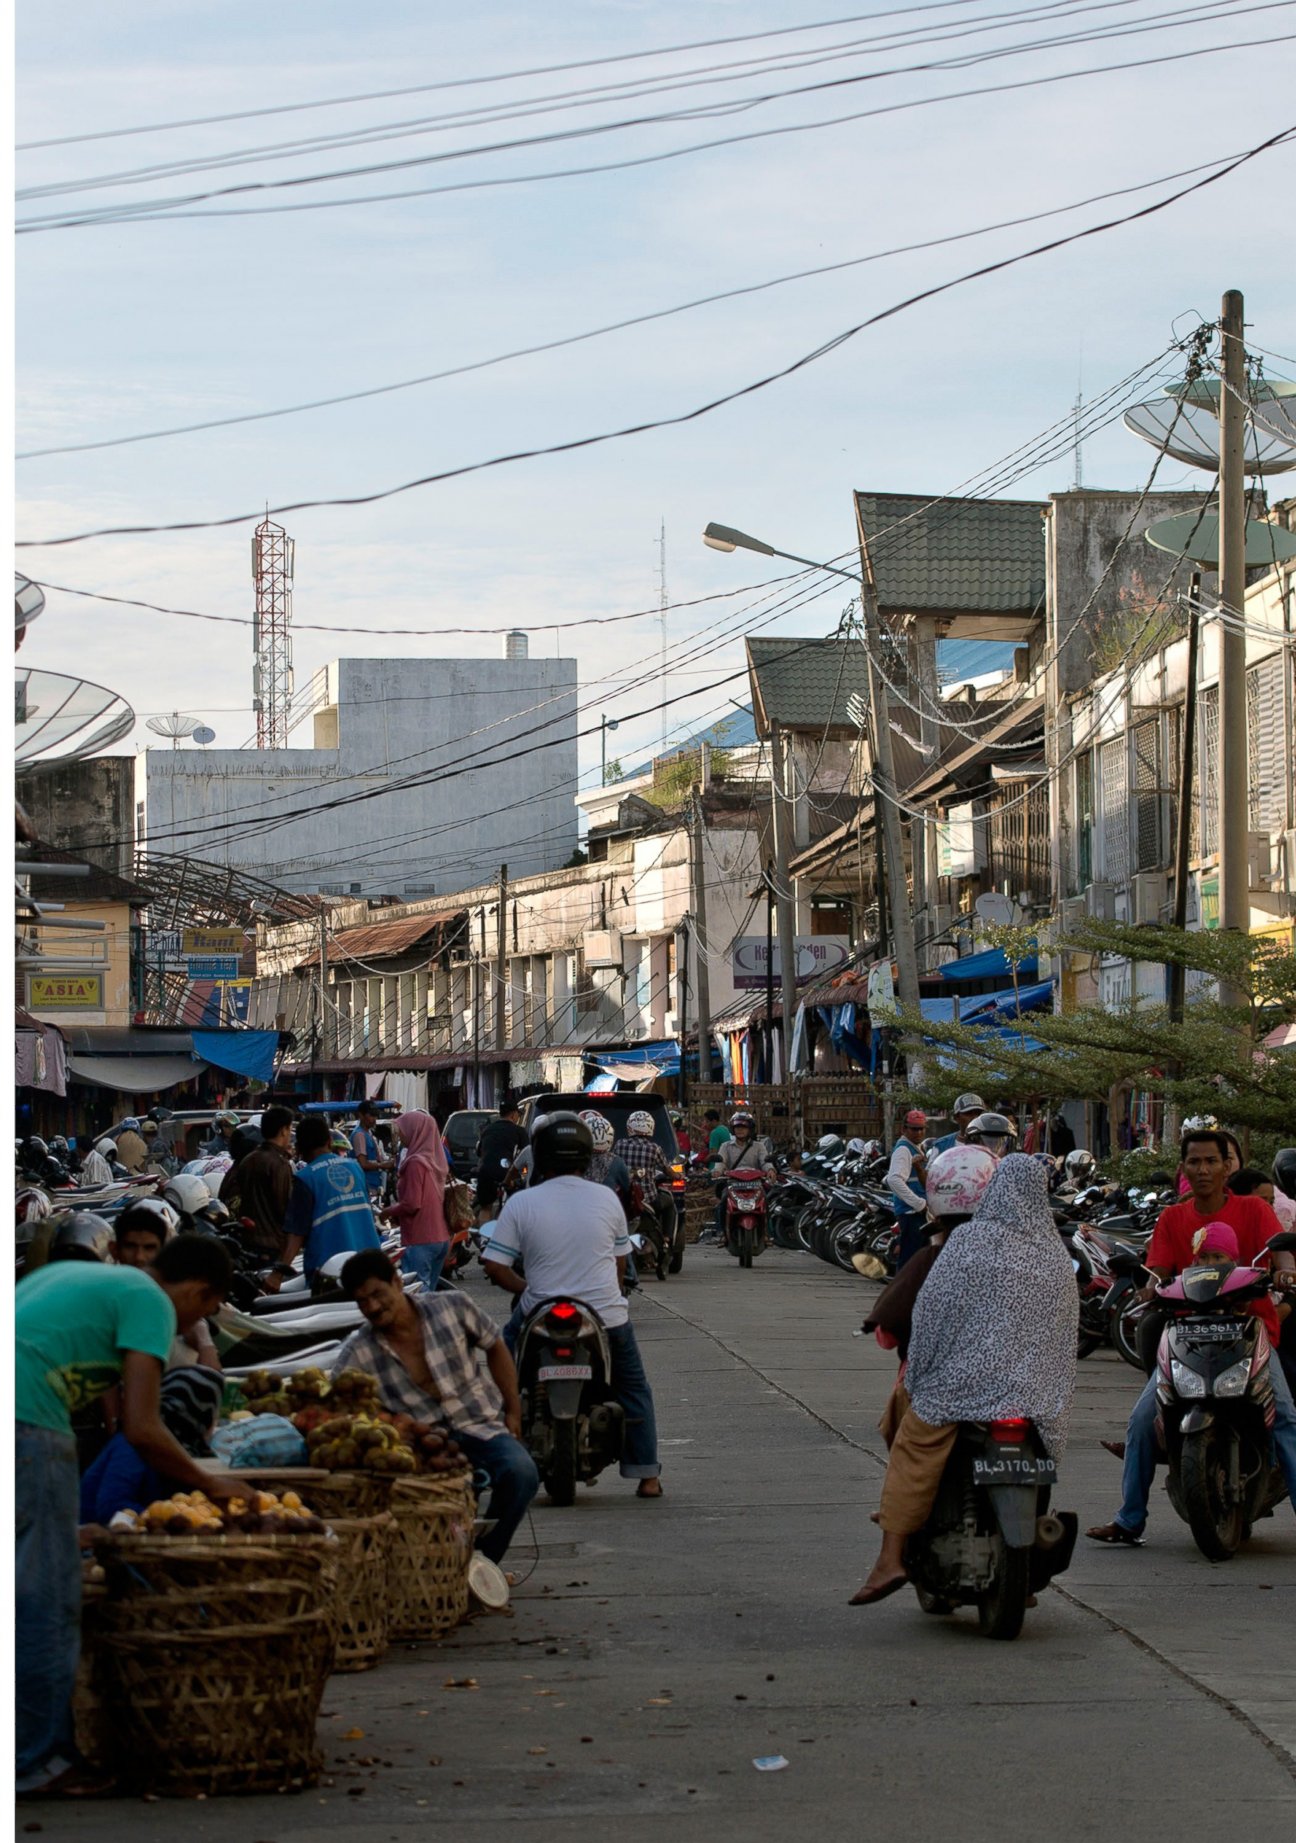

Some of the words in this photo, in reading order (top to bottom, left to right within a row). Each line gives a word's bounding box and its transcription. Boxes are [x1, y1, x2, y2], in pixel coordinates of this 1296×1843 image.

[45, 984, 86, 996] ASIA
[1177, 1325, 1192, 1334] BL
[1193, 1324, 1226, 1334] 3696
[974, 1460, 991, 1473] BL
[996, 1460, 1030, 1472] 3170
